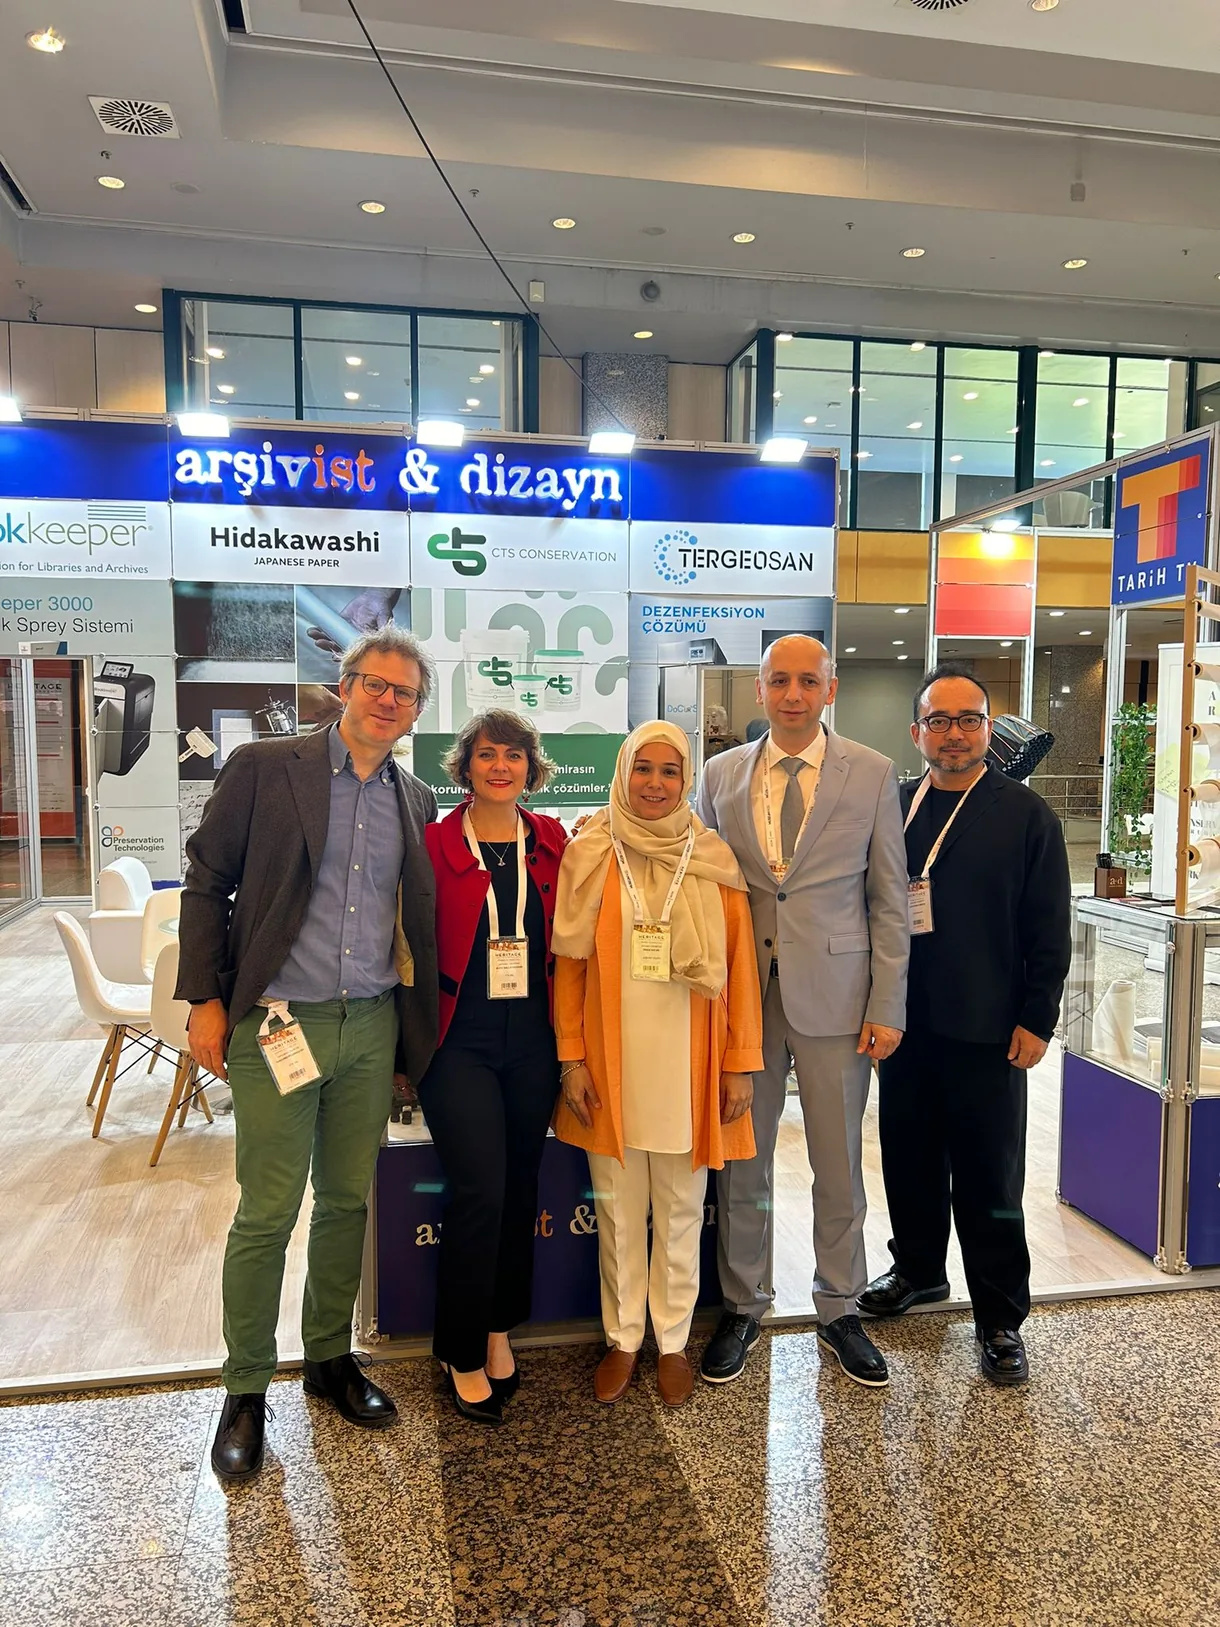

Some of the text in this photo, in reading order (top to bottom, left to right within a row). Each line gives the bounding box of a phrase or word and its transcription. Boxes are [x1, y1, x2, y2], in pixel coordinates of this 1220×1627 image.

[175, 441, 623, 510] arşivist & dizayn
[210, 526, 380, 552] Hidakawashi
[254, 556, 340, 568] JAPANESE PAPER
[491, 547, 617, 562] CTS CONSERVATION
[678, 548, 814, 571] TERGEOSAN
[18, 561, 34, 571] for
[37, 561, 82, 572] Libraries
[85, 563, 103, 572] and
[105, 563, 149, 574] Archives
[1176, 560, 1198, 582] T
[48, 596, 93, 611] 3000
[17, 616, 67, 636] Sprey
[72, 617, 133, 633] Sistemi
[642, 619, 706, 634] ÇÖZÜMÜ
[113, 836, 164, 844] Preservation
[113, 844, 165, 852] Technologies
[569, 1204, 598, 1235] &
